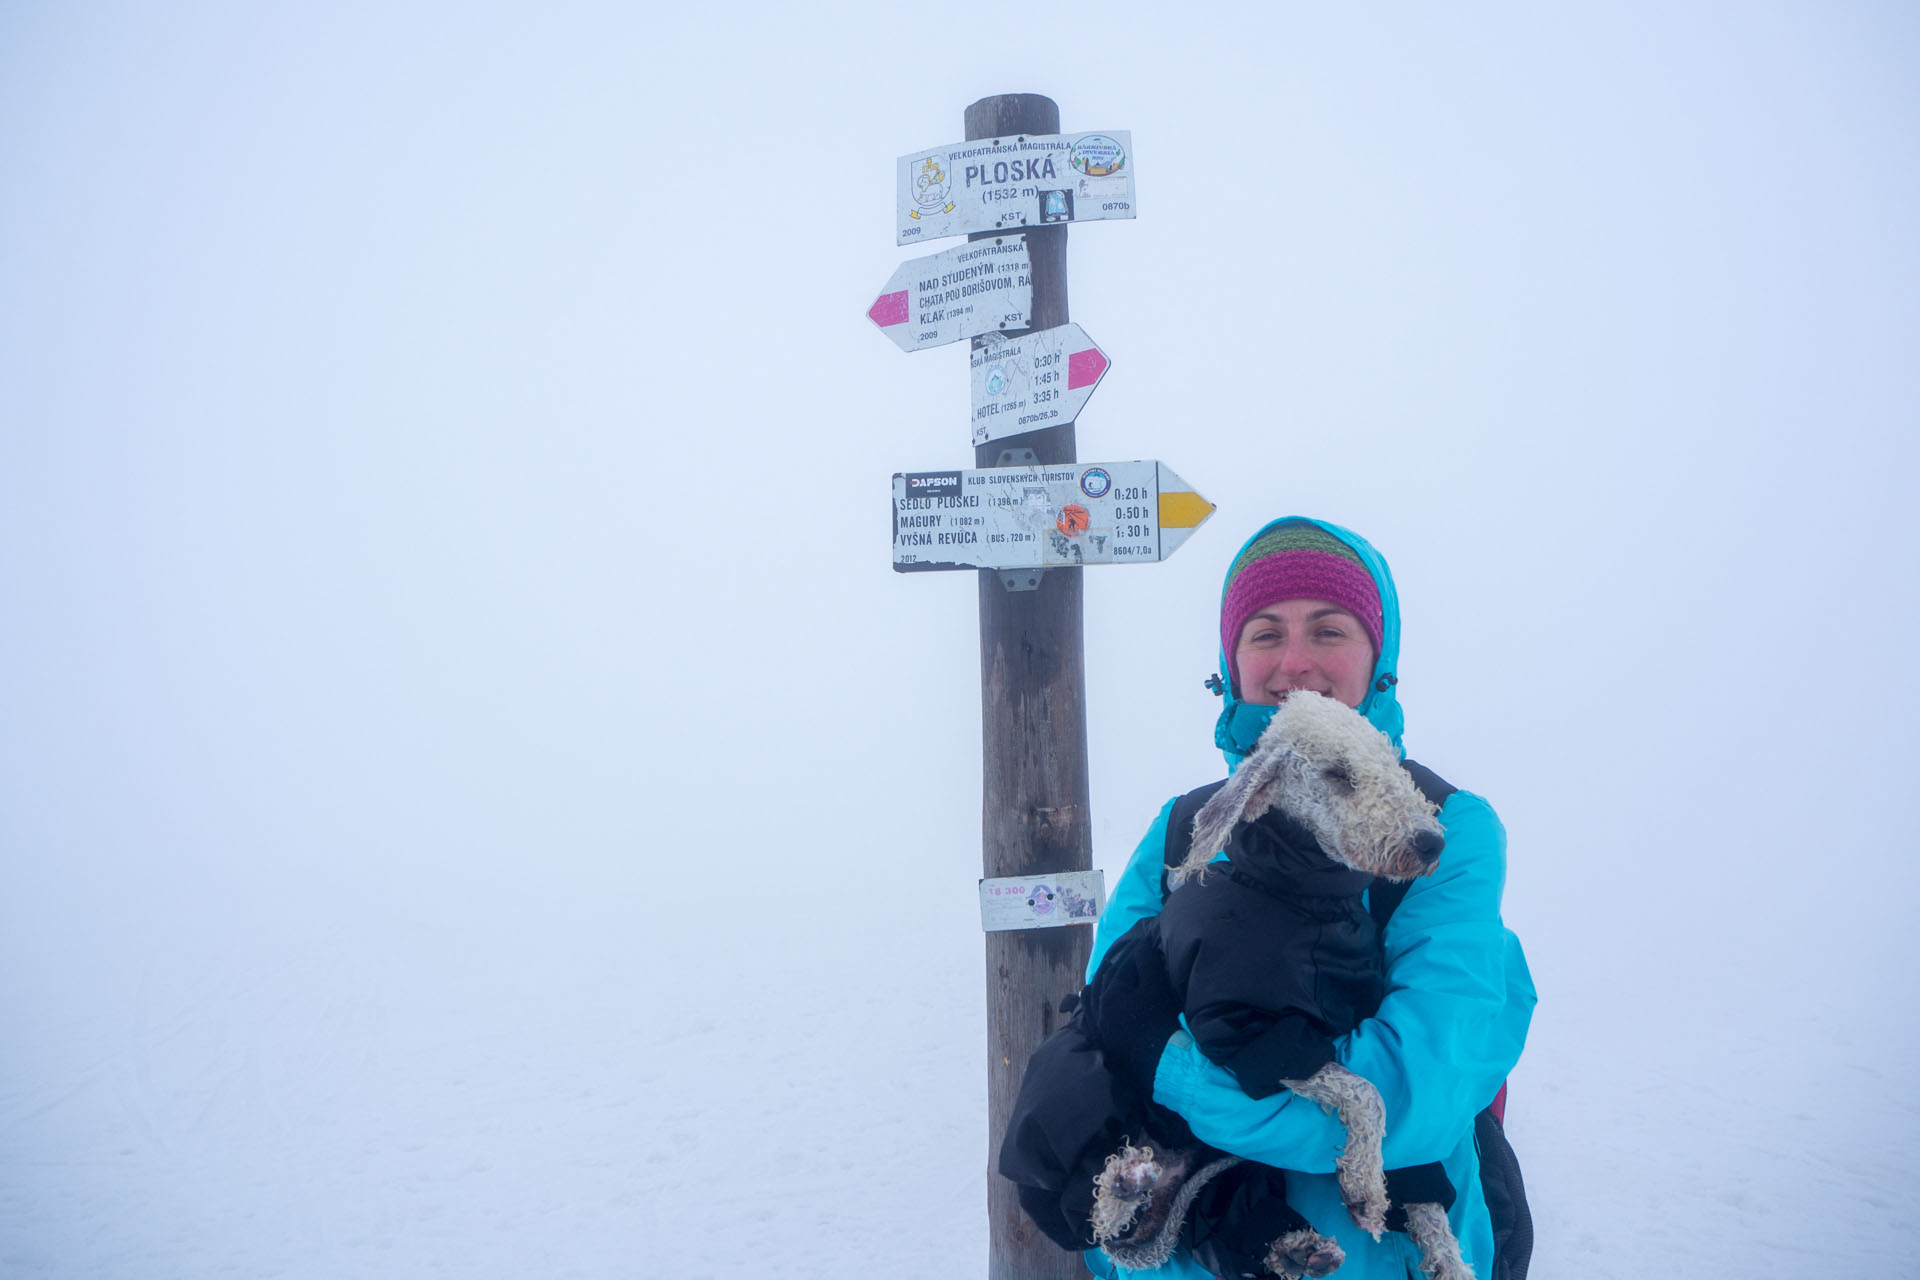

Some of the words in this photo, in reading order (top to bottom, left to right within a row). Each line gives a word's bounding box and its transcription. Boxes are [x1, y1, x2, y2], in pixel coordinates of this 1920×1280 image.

[1020, 141, 1072, 152] MAGISTRÁLA
[965, 153, 1057, 188] PLOSKÁ
[982, 187, 1018, 205] (1532
[1022, 184, 1039, 200] m)
[1102, 202, 1130, 211] 0870b
[1001, 211, 1021, 222] KST
[902, 226, 921, 238] 2009
[919, 277, 938, 293] NAD
[942, 261, 994, 287] STUDENÝM
[919, 293, 944, 309] CHATA
[945, 289, 960, 304] POD
[961, 277, 1016, 301] BORIŠOVOM,
[1004, 313, 1024, 322] KST
[920, 331, 938, 341] 2009
[1034, 354, 1052, 369] 0:30
[1054, 353, 1060, 364] h
[1034, 373, 1051, 386] 1:45
[1054, 371, 1059, 382] h
[1033, 390, 1051, 404] 3:35
[1053, 388, 1059, 400] h
[977, 402, 1000, 420] HOTEL
[968, 476, 985, 485] KLUB
[989, 473, 1038, 484] SLOVENSKÝCH
[1041, 472, 1075, 482] TURISTOV
[1114, 487, 1138, 501] 0:20
[1141, 487, 1147, 499] h
[900, 497, 931, 510] SEDLO
[937, 496, 979, 509] PLOSKEJ
[1115, 507, 1140, 520] 0:50
[1143, 506, 1149, 518] h
[900, 515, 942, 528] MAGURY
[900, 531, 932, 546] VYŠNÁ
[938, 530, 978, 545] REVÚCA
[1010, 533, 1024, 542] 720
[1144, 525, 1150, 537] h
[900, 555, 917, 563] 2012
